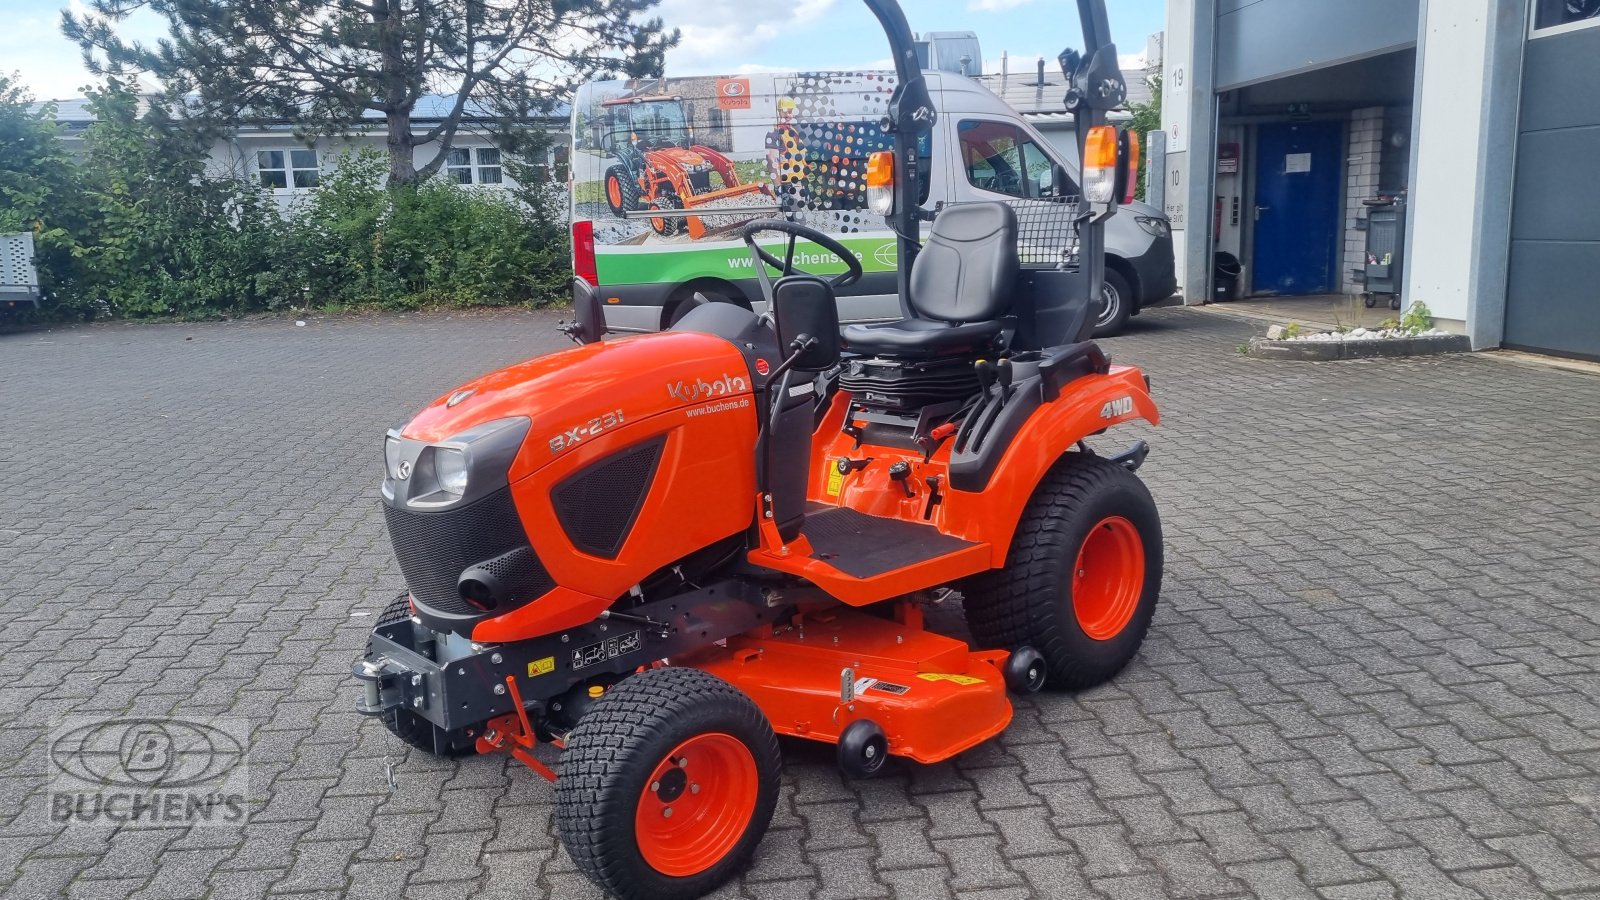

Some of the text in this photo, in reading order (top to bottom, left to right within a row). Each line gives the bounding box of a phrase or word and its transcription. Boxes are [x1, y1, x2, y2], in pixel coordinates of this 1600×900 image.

[1172, 67, 1184, 88] 19
[1171, 169, 1180, 187] 10
[727, 249, 864, 269] wwchense
[667, 373, 746, 401] Kubota
[686, 398, 749, 418] www.buchens.de
[1100, 396, 1133, 419] 4WD
[549, 409, 625, 454] BX-231
